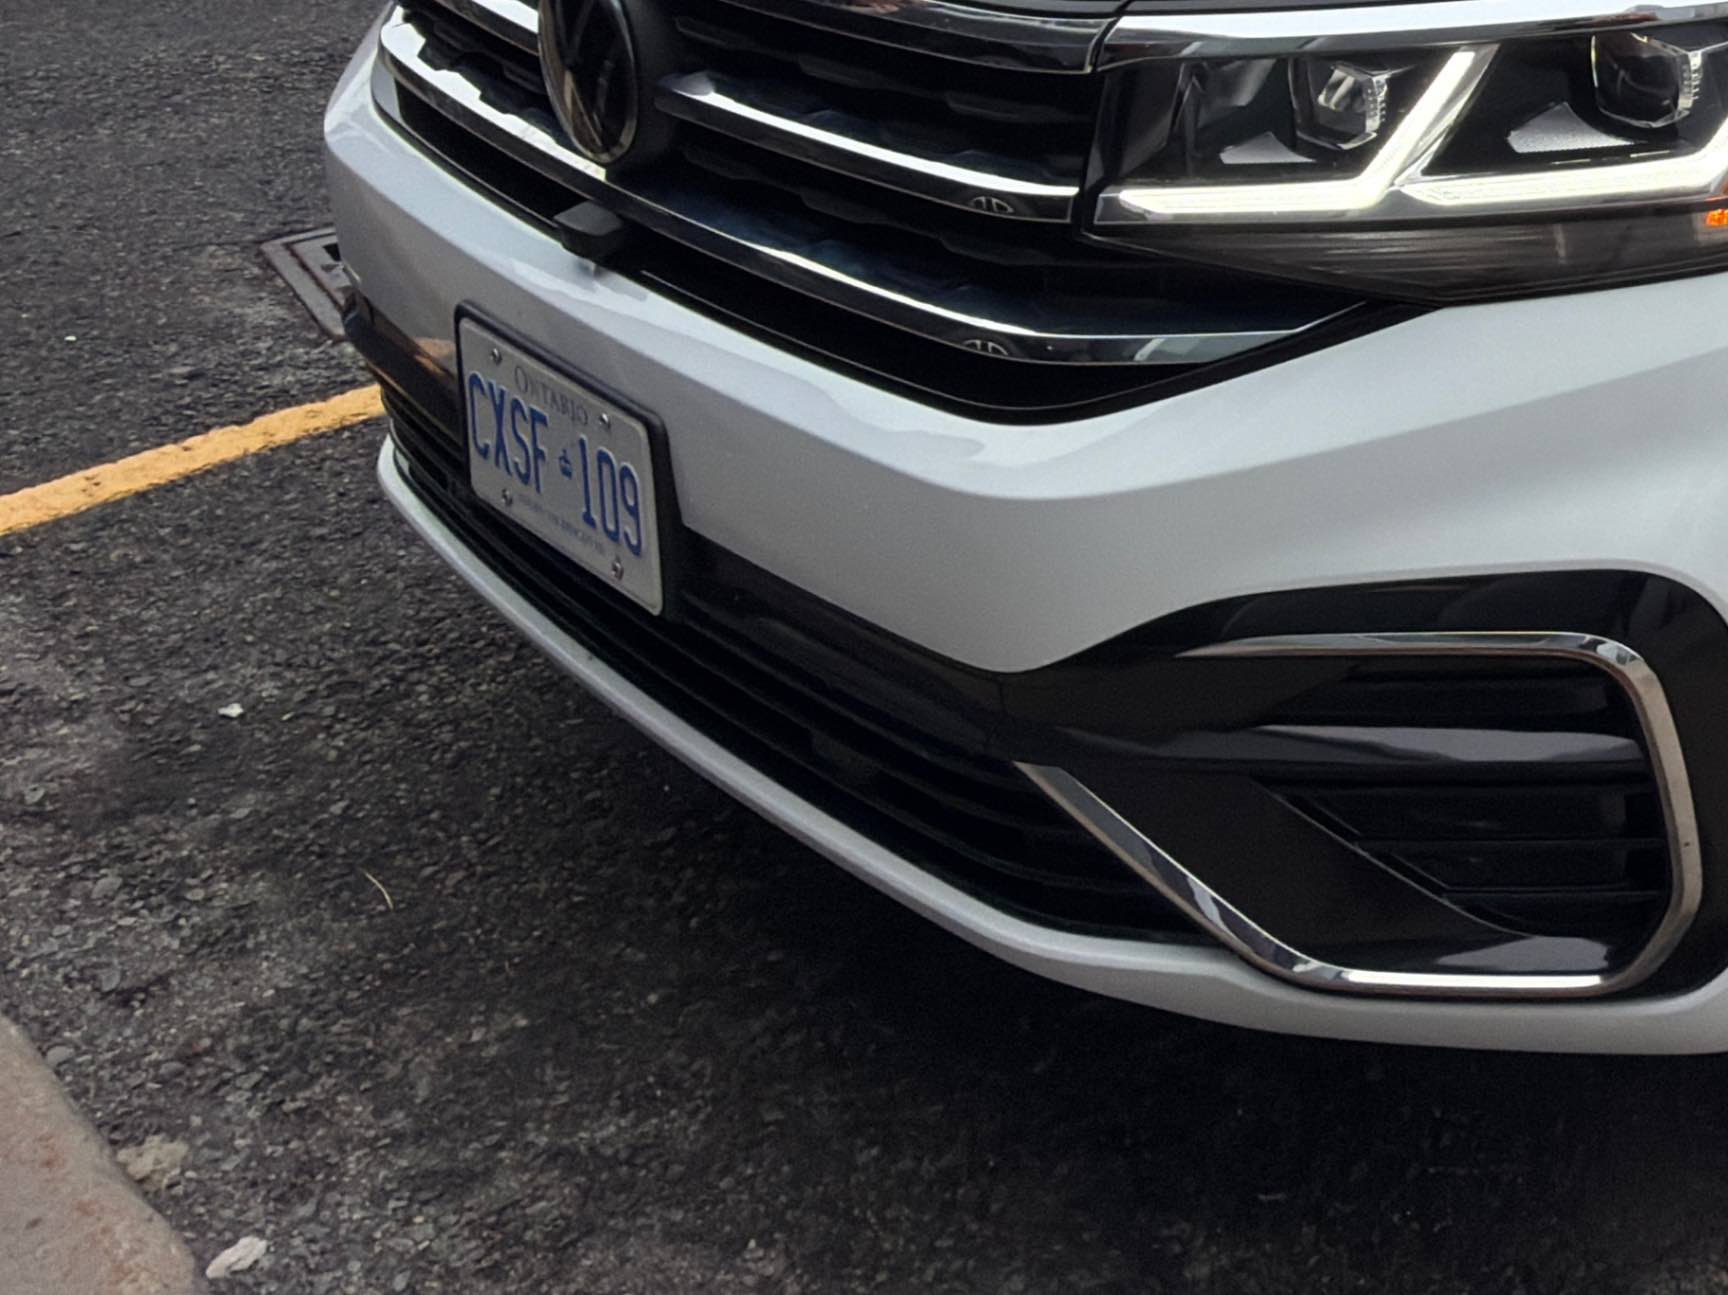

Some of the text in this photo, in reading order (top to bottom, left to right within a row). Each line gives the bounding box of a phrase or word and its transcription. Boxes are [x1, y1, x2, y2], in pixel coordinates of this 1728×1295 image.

[514, 365, 588, 426] ONTARIO
[468, 372, 549, 494] CXSF
[579, 435, 642, 558] 109
